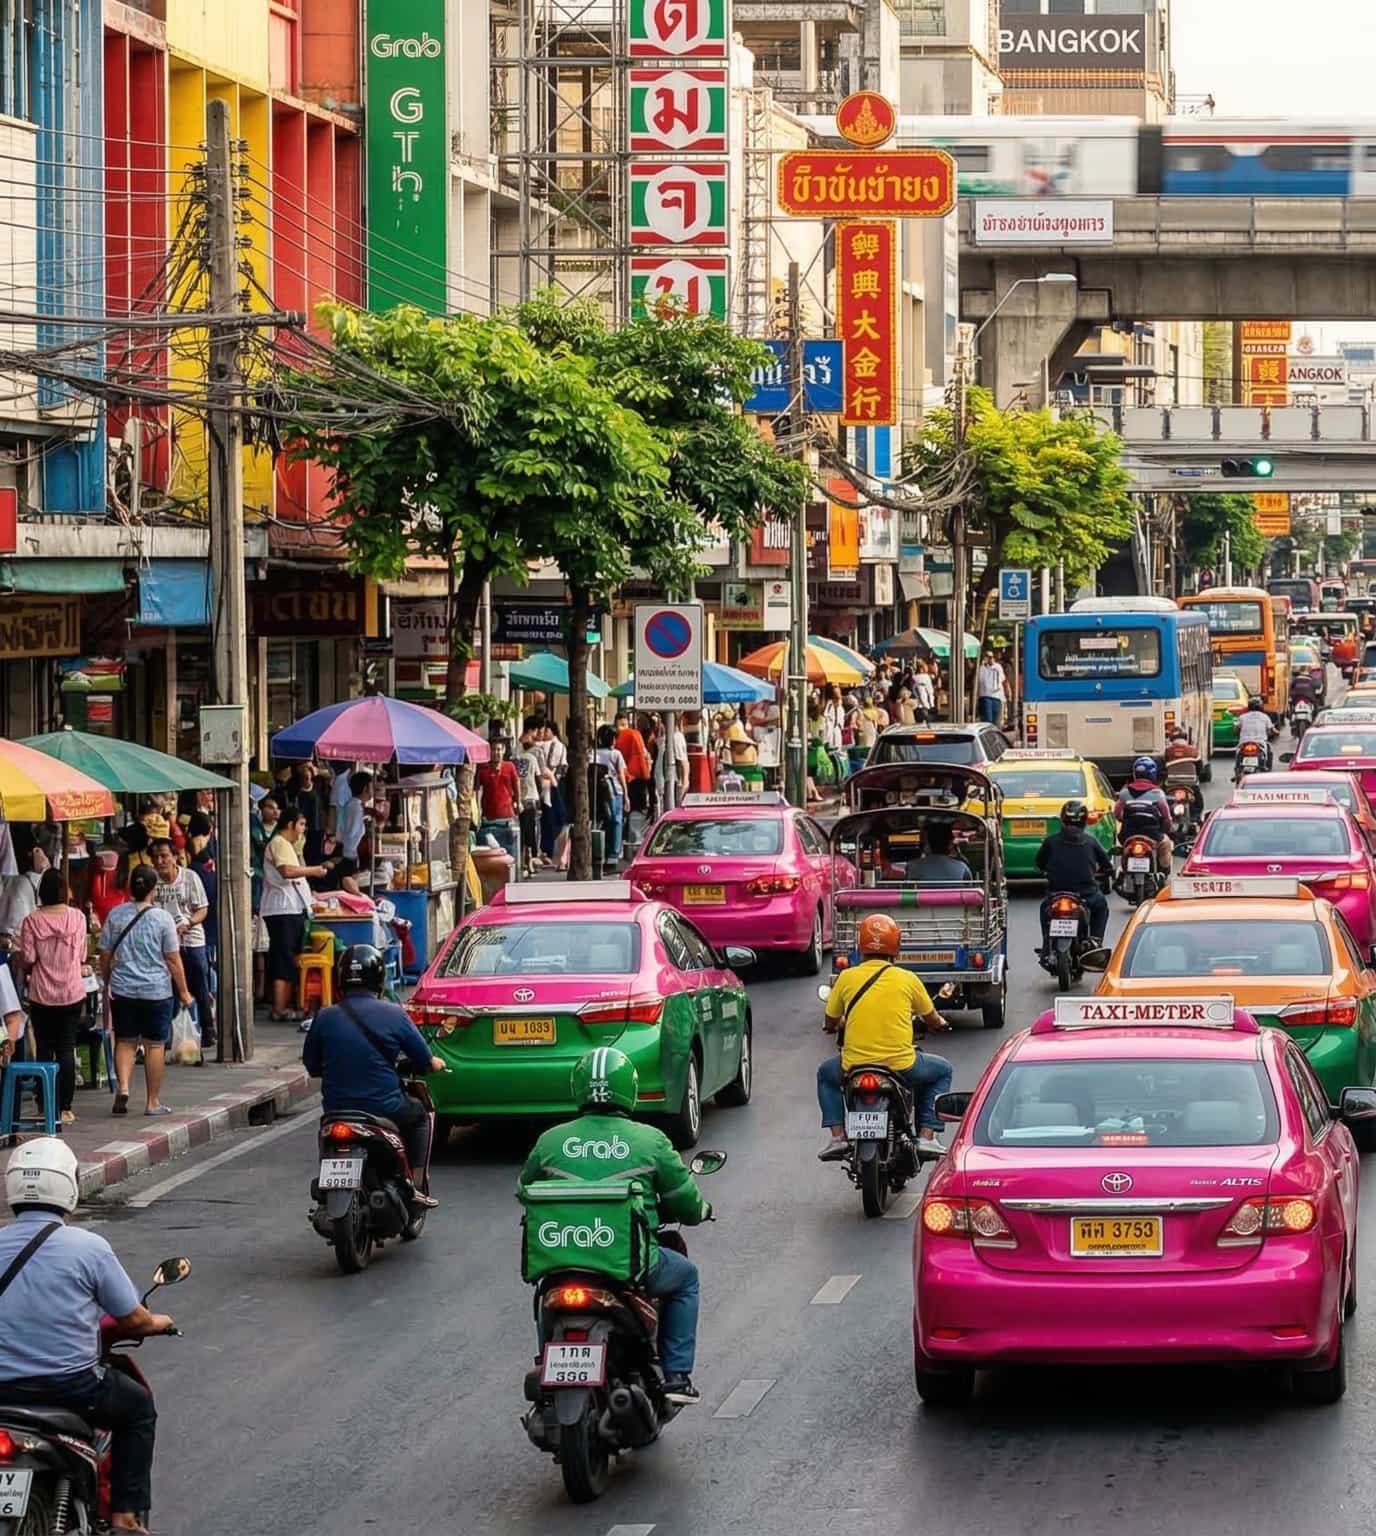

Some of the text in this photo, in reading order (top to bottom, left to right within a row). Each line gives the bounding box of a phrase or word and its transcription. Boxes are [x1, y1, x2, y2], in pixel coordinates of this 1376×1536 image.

[371, 32, 441, 58] Grab
[999, 29, 1141, 53] BANGKOK
[1080, 1004, 1206, 1020] TAXI-METER
[562, 1135, 630, 1160] Grab
[1220, 1177, 1264, 1186] ALTIS
[538, 1218, 615, 1248] Grab
[1112, 1222, 1153, 1238] 3753
